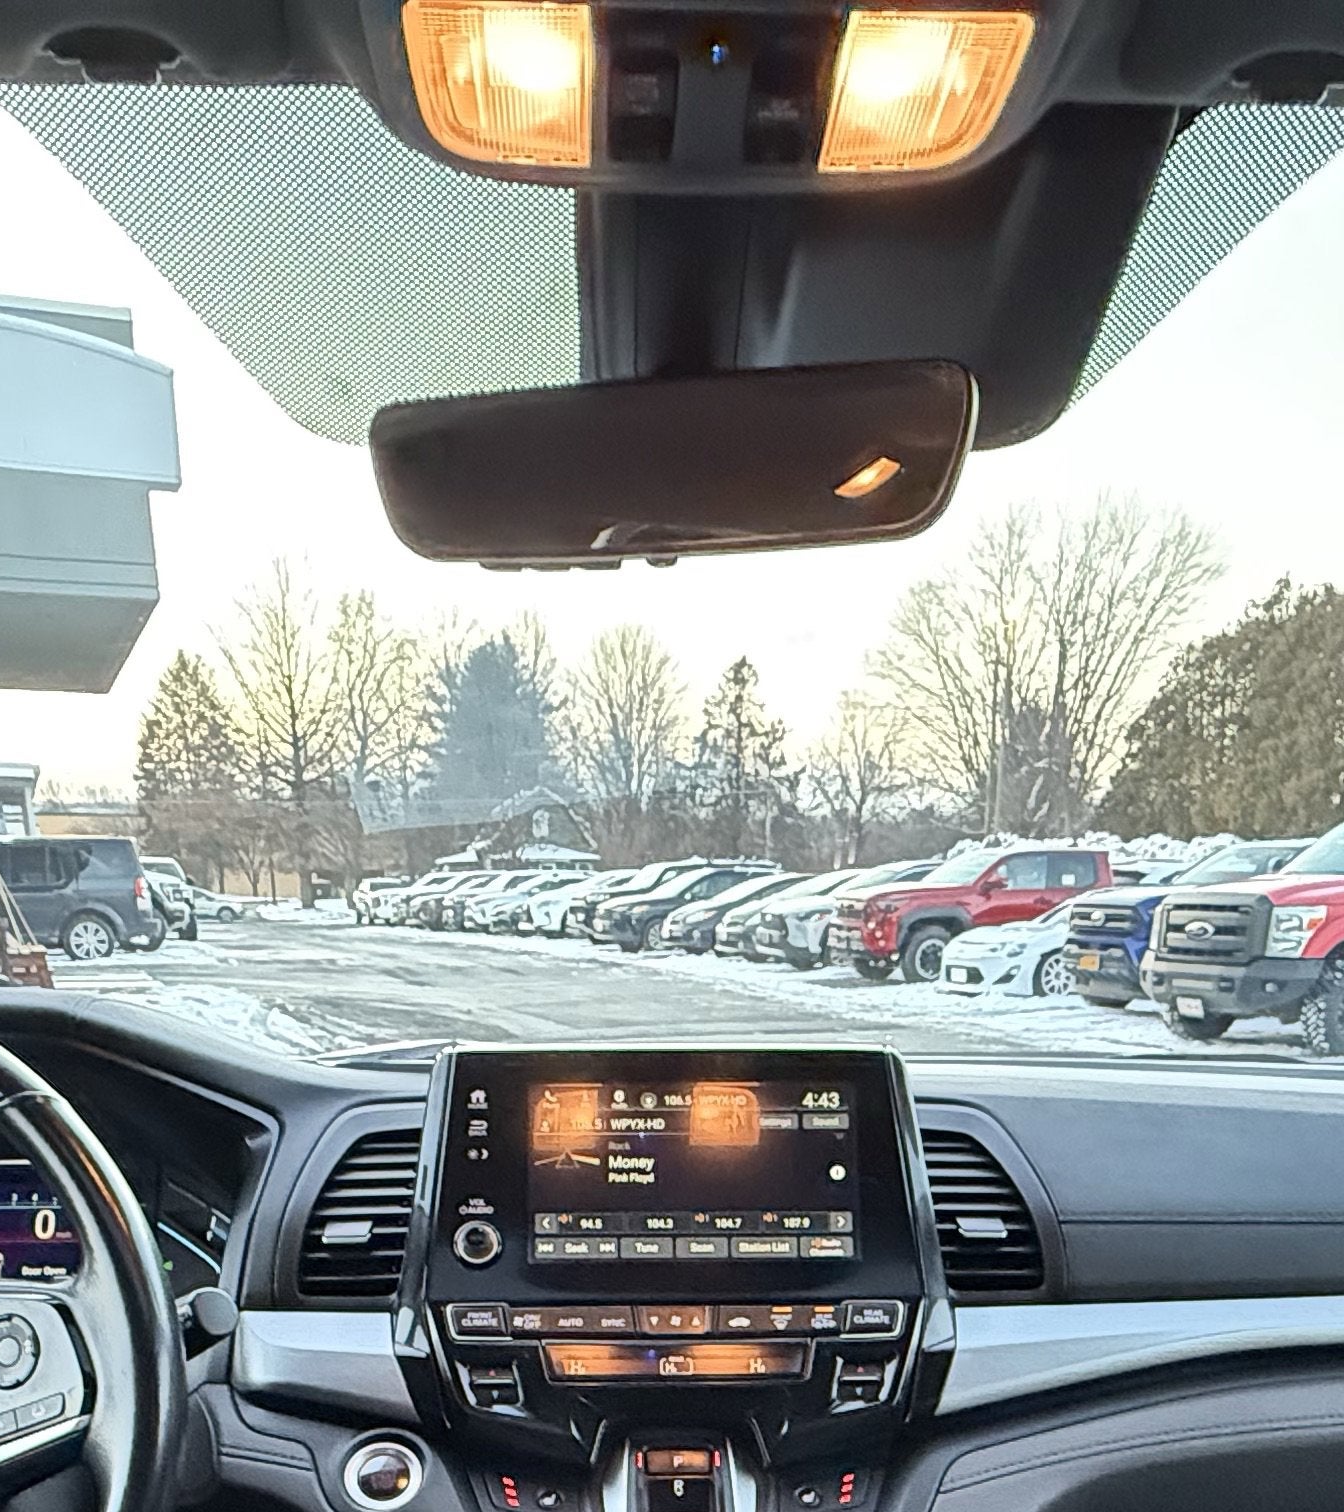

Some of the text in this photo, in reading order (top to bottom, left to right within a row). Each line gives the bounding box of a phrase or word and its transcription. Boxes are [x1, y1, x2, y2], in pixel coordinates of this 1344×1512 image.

[802, 1091, 841, 1109] 4:43
[610, 1118, 666, 1131] WPYX-HD
[608, 1155, 655, 1172] Money
[34, 1208, 57, 1241] 0
[558, 1317, 584, 1327] AUTO
[601, 1317, 626, 1328] SYNC
